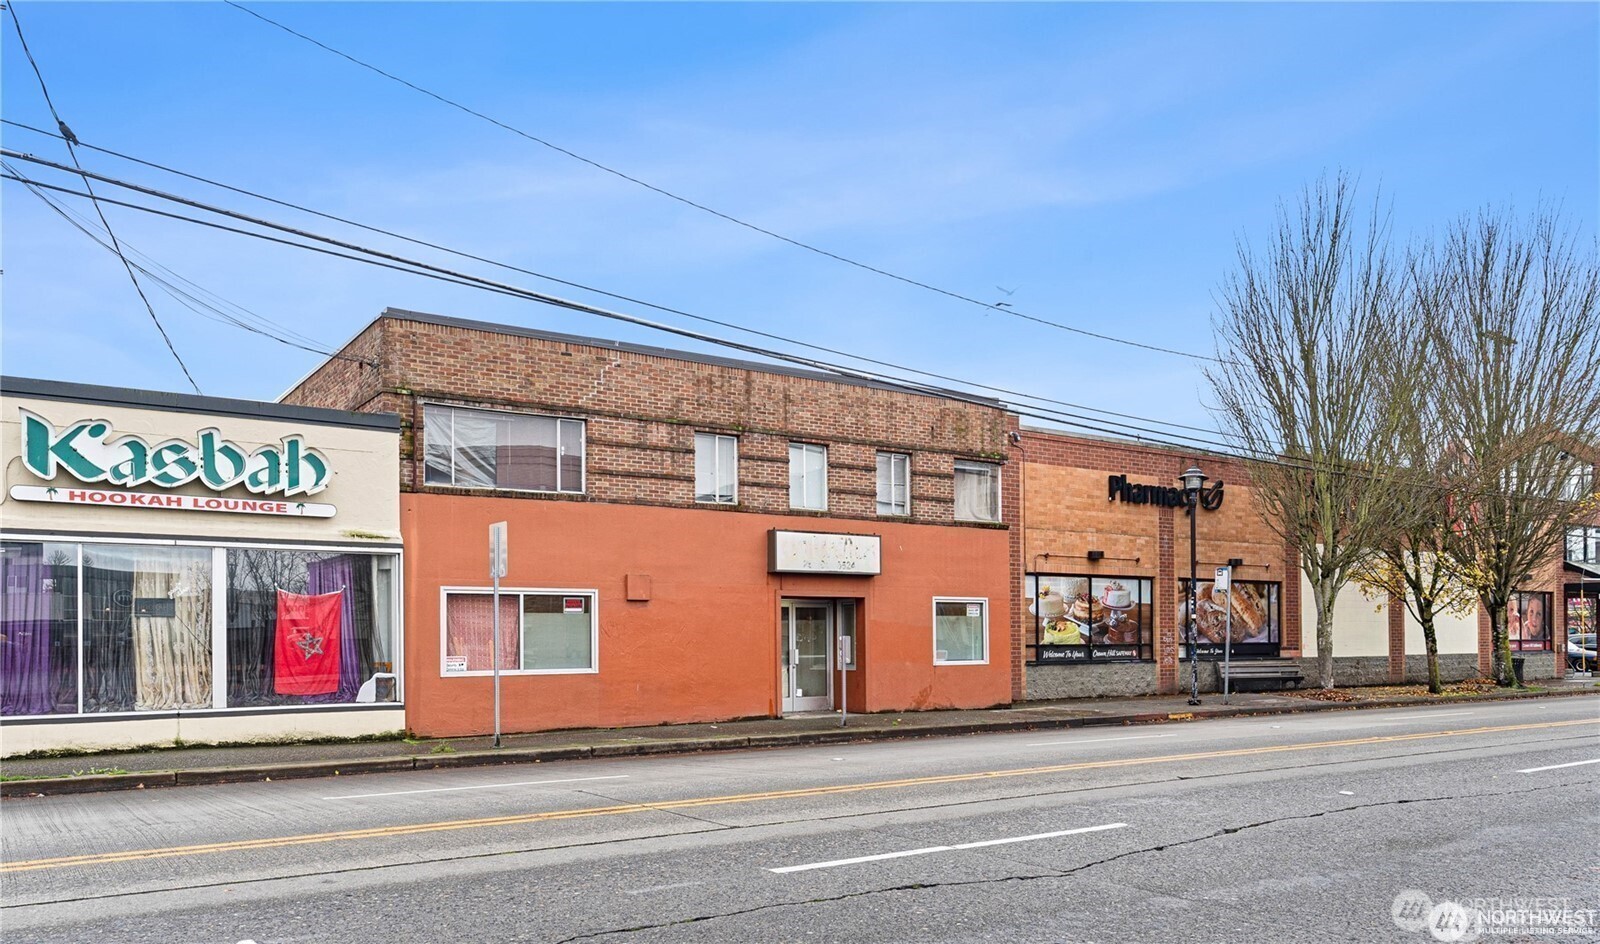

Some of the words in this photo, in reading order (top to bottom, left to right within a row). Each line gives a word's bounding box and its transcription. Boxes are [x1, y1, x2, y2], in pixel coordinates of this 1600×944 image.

[20, 407, 333, 497] Kasbah
[68, 490, 182, 507] HOOKAH
[193, 498, 288, 514] LOUNGE
[1043, 650, 1064, 658] Welcome
[1065, 650, 1072, 658] To
[1072, 650, 1085, 659] Your
